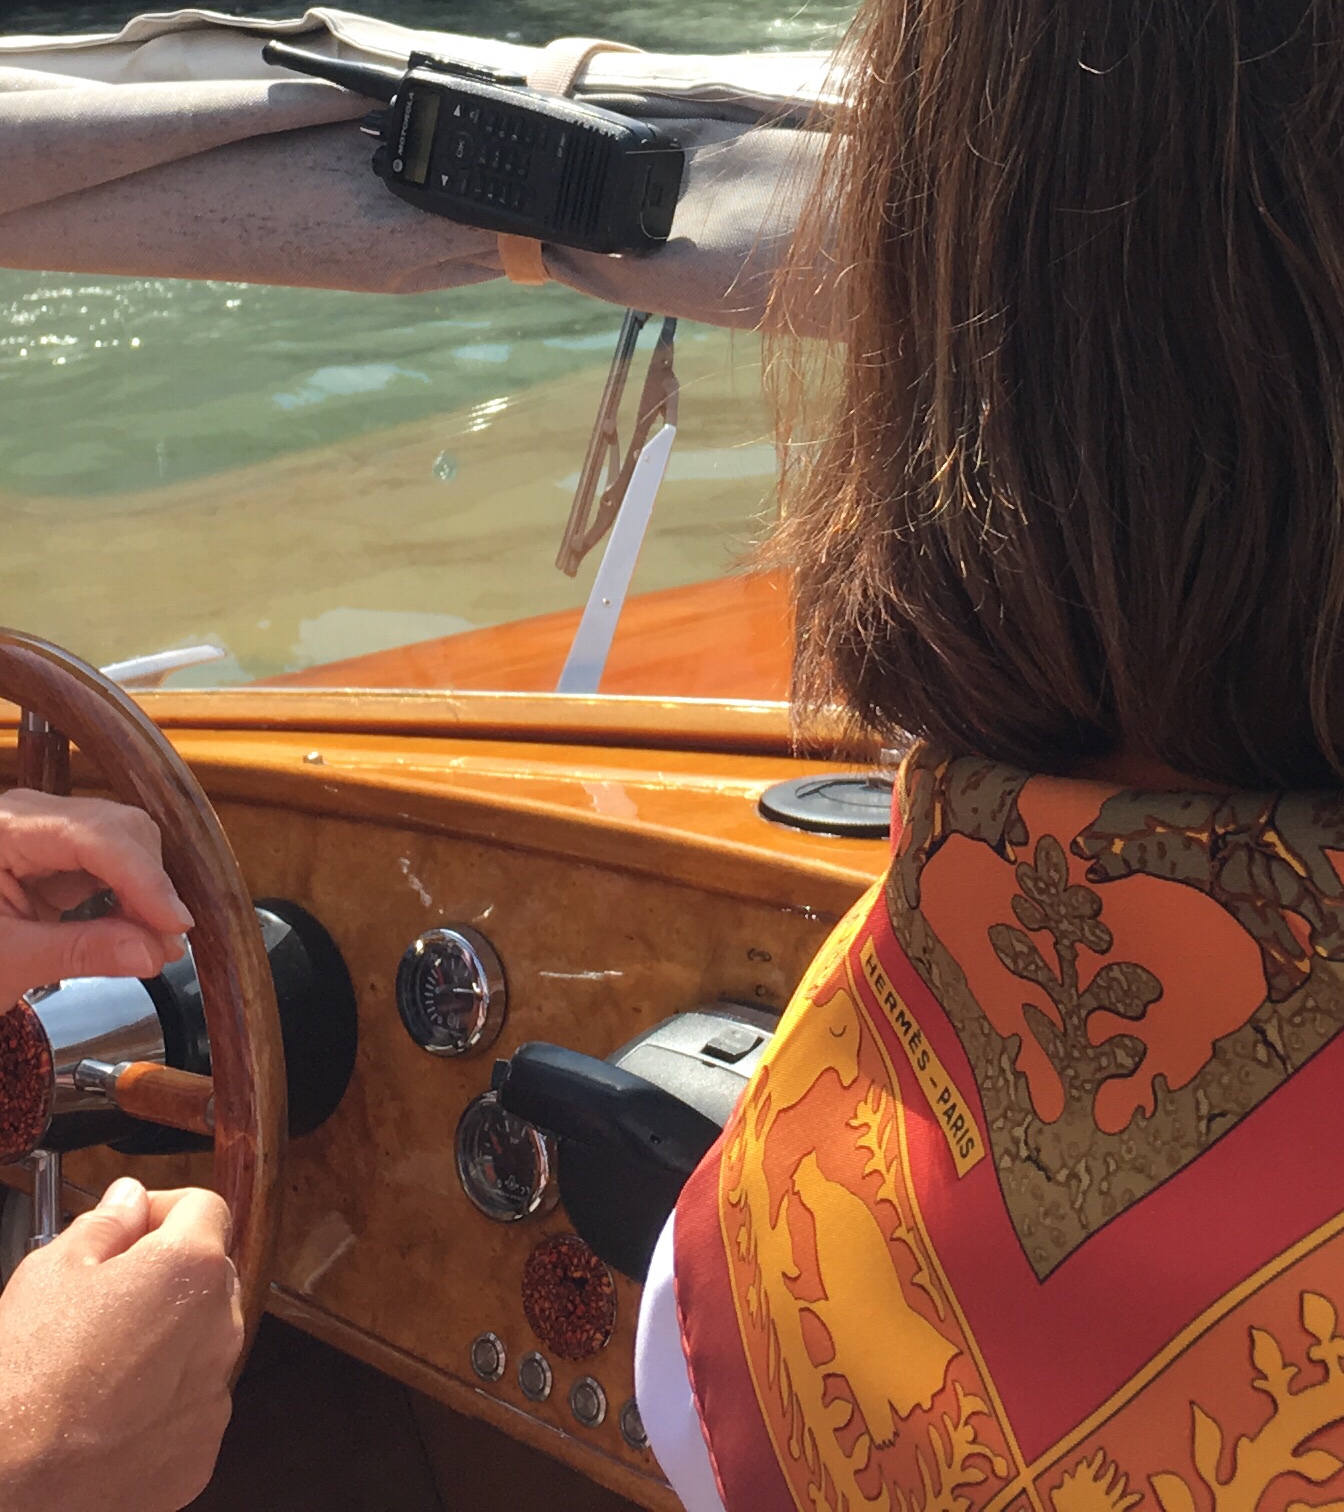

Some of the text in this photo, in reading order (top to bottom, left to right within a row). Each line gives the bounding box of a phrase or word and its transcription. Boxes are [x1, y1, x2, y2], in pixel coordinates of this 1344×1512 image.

[398, 92, 414, 156] MOTOROLA
[865, 954, 931, 1073] HERMÈS
[936, 1086, 978, 1160] PARIS
